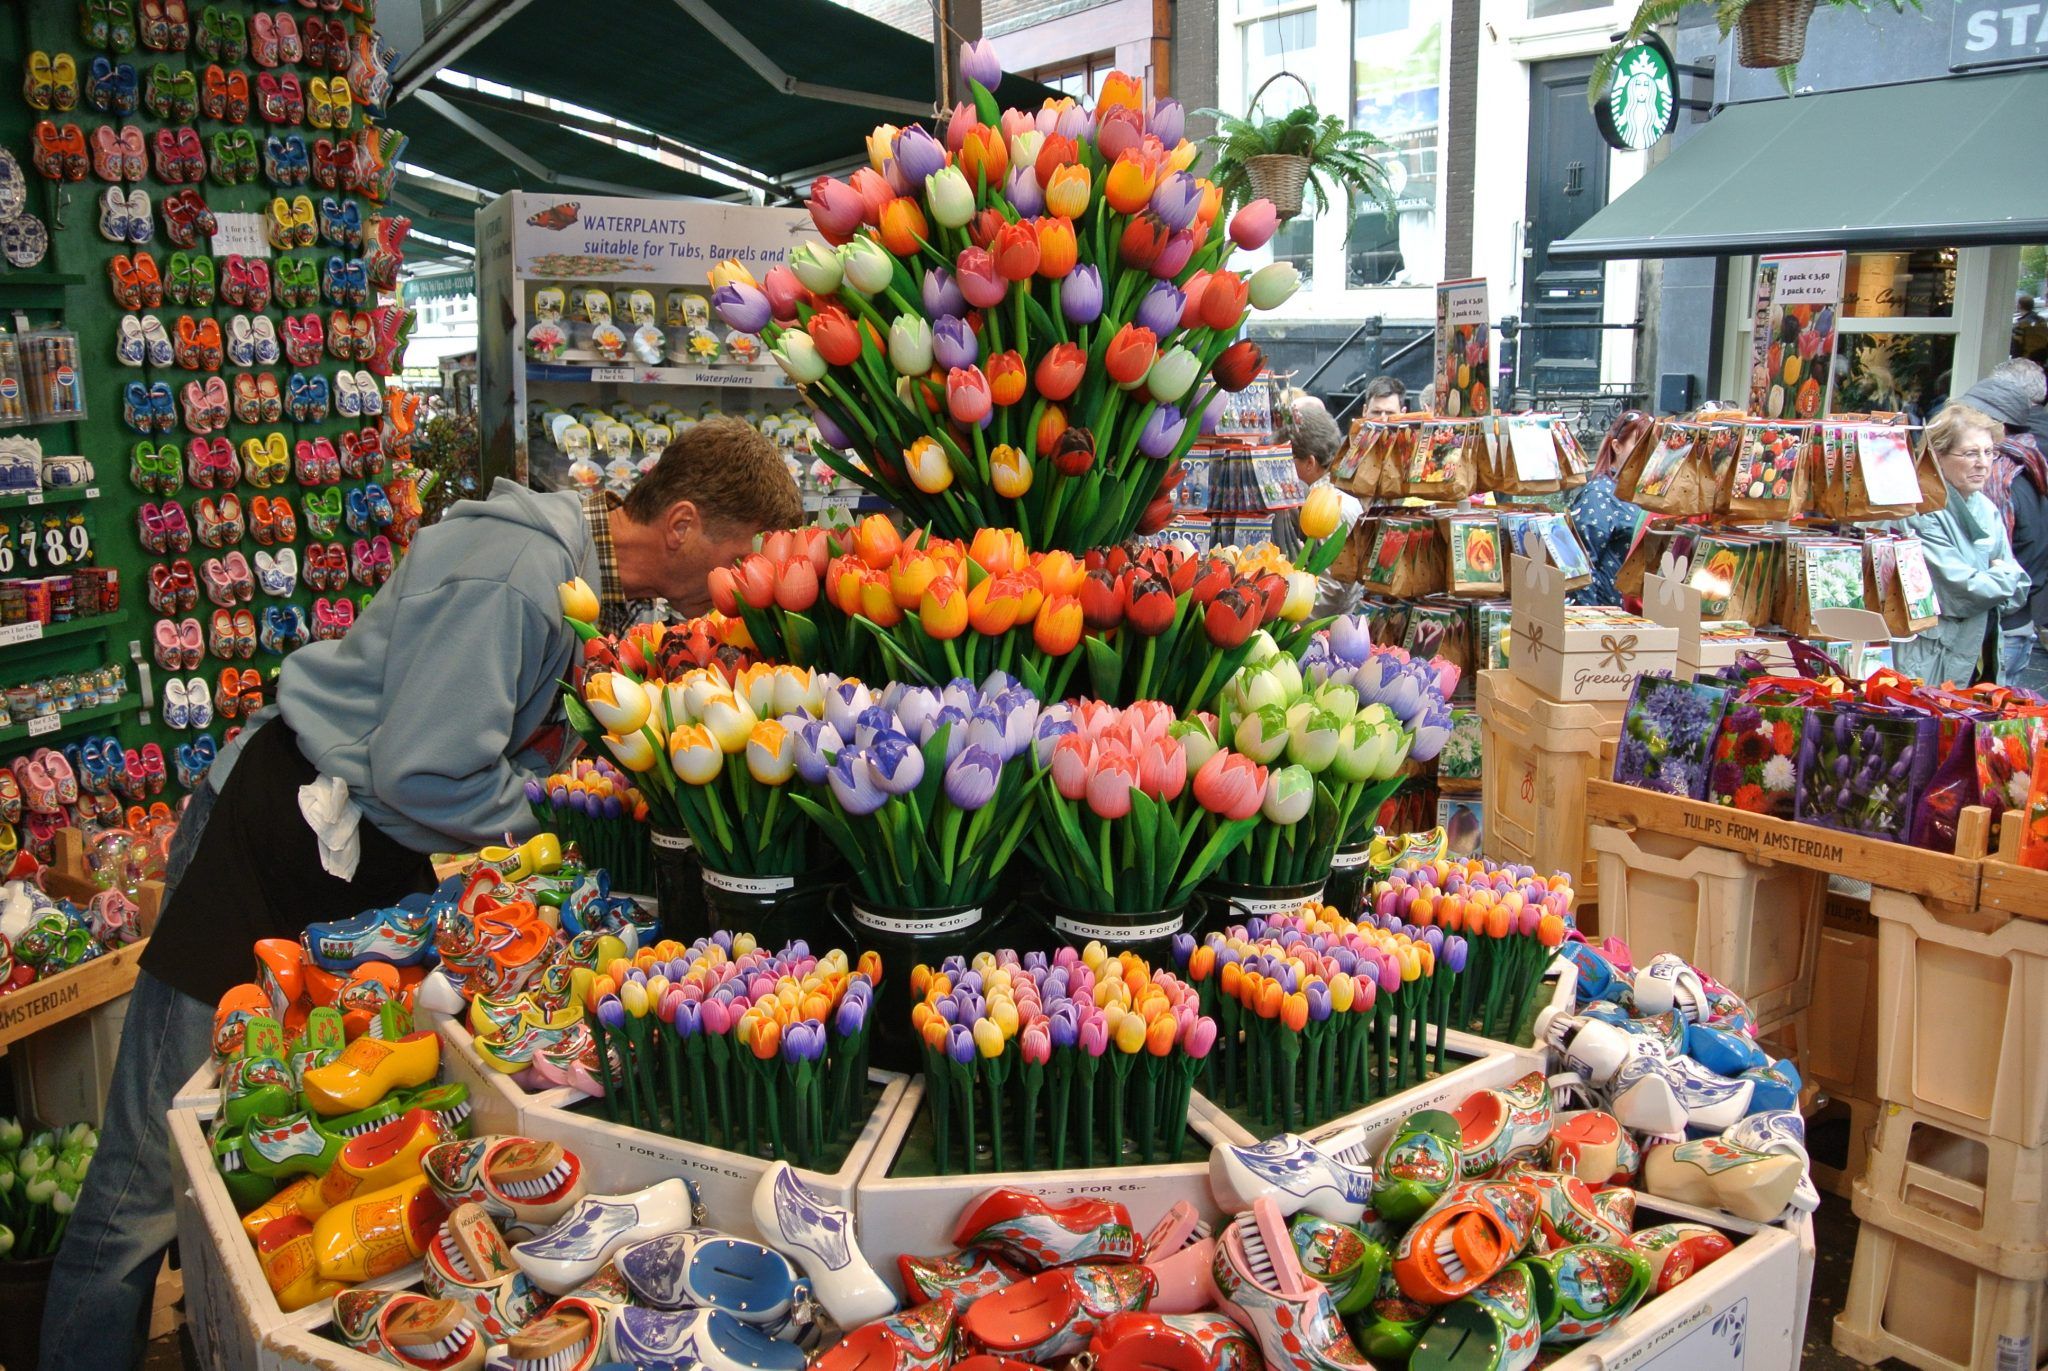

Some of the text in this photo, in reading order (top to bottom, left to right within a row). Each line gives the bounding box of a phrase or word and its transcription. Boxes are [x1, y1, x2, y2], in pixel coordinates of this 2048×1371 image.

[583, 216, 686, 235] WATERPLANTS
[583, 239, 638, 256] suitable
[643, 240, 664, 259] for
[669, 242, 704, 260] Tubs,
[709, 245, 756, 262] Barrels
[760, 247, 785, 262] and
[1788, 273, 1806, 281] pack
[1814, 273, 1830, 281] 3,50
[1786, 287, 1805, 296] pack
[695, 373, 753, 385] Waterplants
[20, 531, 38, 567] 7
[45, 529, 68, 566] 8
[69, 525, 89, 562] 9
[1683, 812, 1843, 863] TULIPS FROM AMSTERDAM
[713, 877, 733, 888] FOR
[1074, 925, 1100, 935] FOR
[1149, 925, 1170, 935] FOR
[1363, 1121, 1381, 1133] OR
[1409, 1100, 1430, 1114] FOR
[630, 1146, 656, 1158] FOR
[693, 1161, 719, 1174] FOR
[1080, 1185, 1112, 1193] FOR
[1655, 1329, 1675, 1344] FOR
